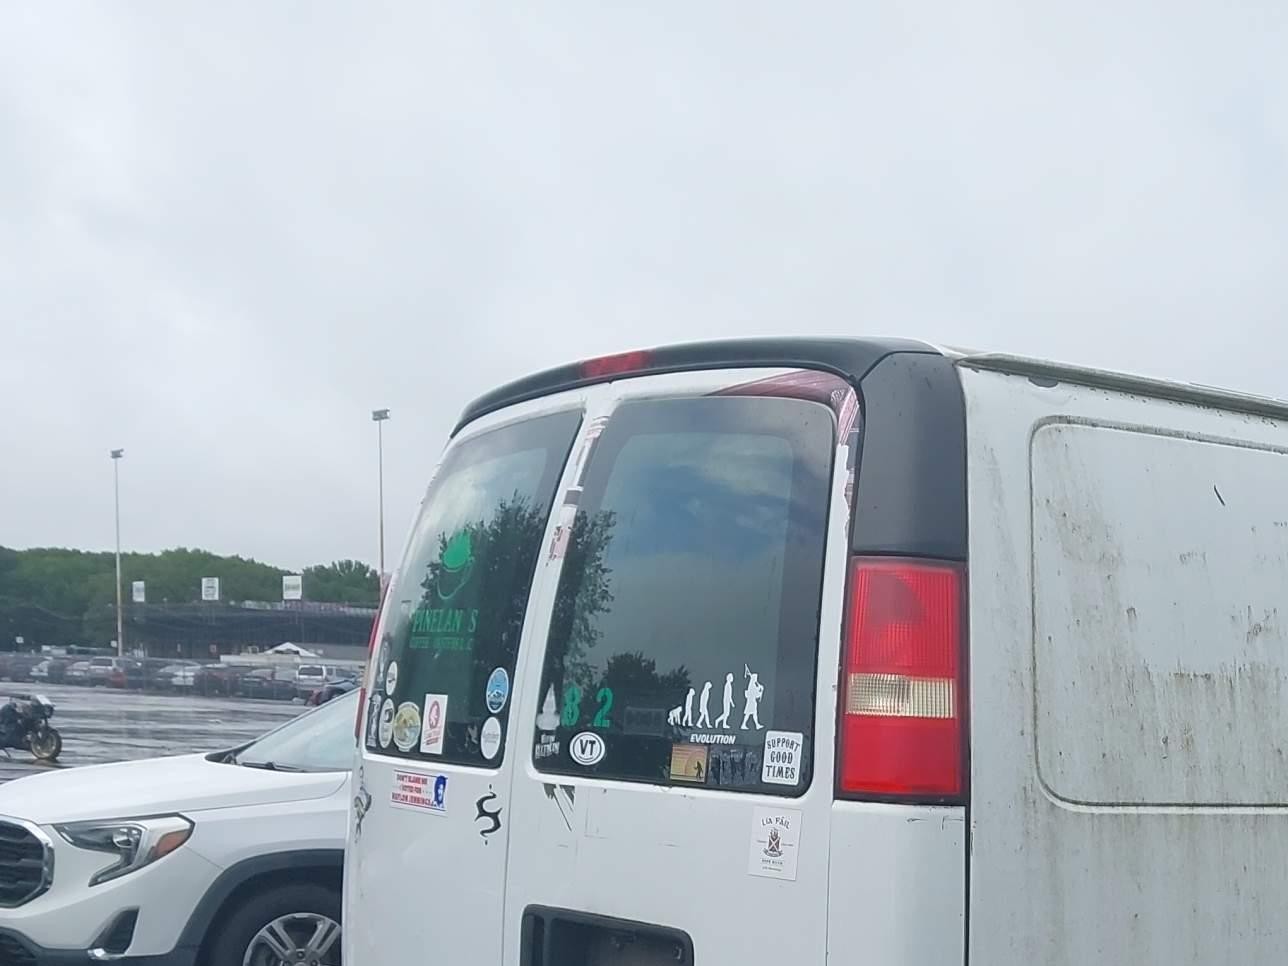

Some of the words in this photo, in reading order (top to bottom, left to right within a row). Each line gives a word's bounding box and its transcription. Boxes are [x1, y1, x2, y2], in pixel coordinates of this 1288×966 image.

[690, 733, 736, 745] EVOLUTION
[766, 737, 801, 752] SUPPORT
[579, 738, 597, 756] VT
[770, 751, 793, 764] GOOD
[765, 765, 796, 779] TIMES
